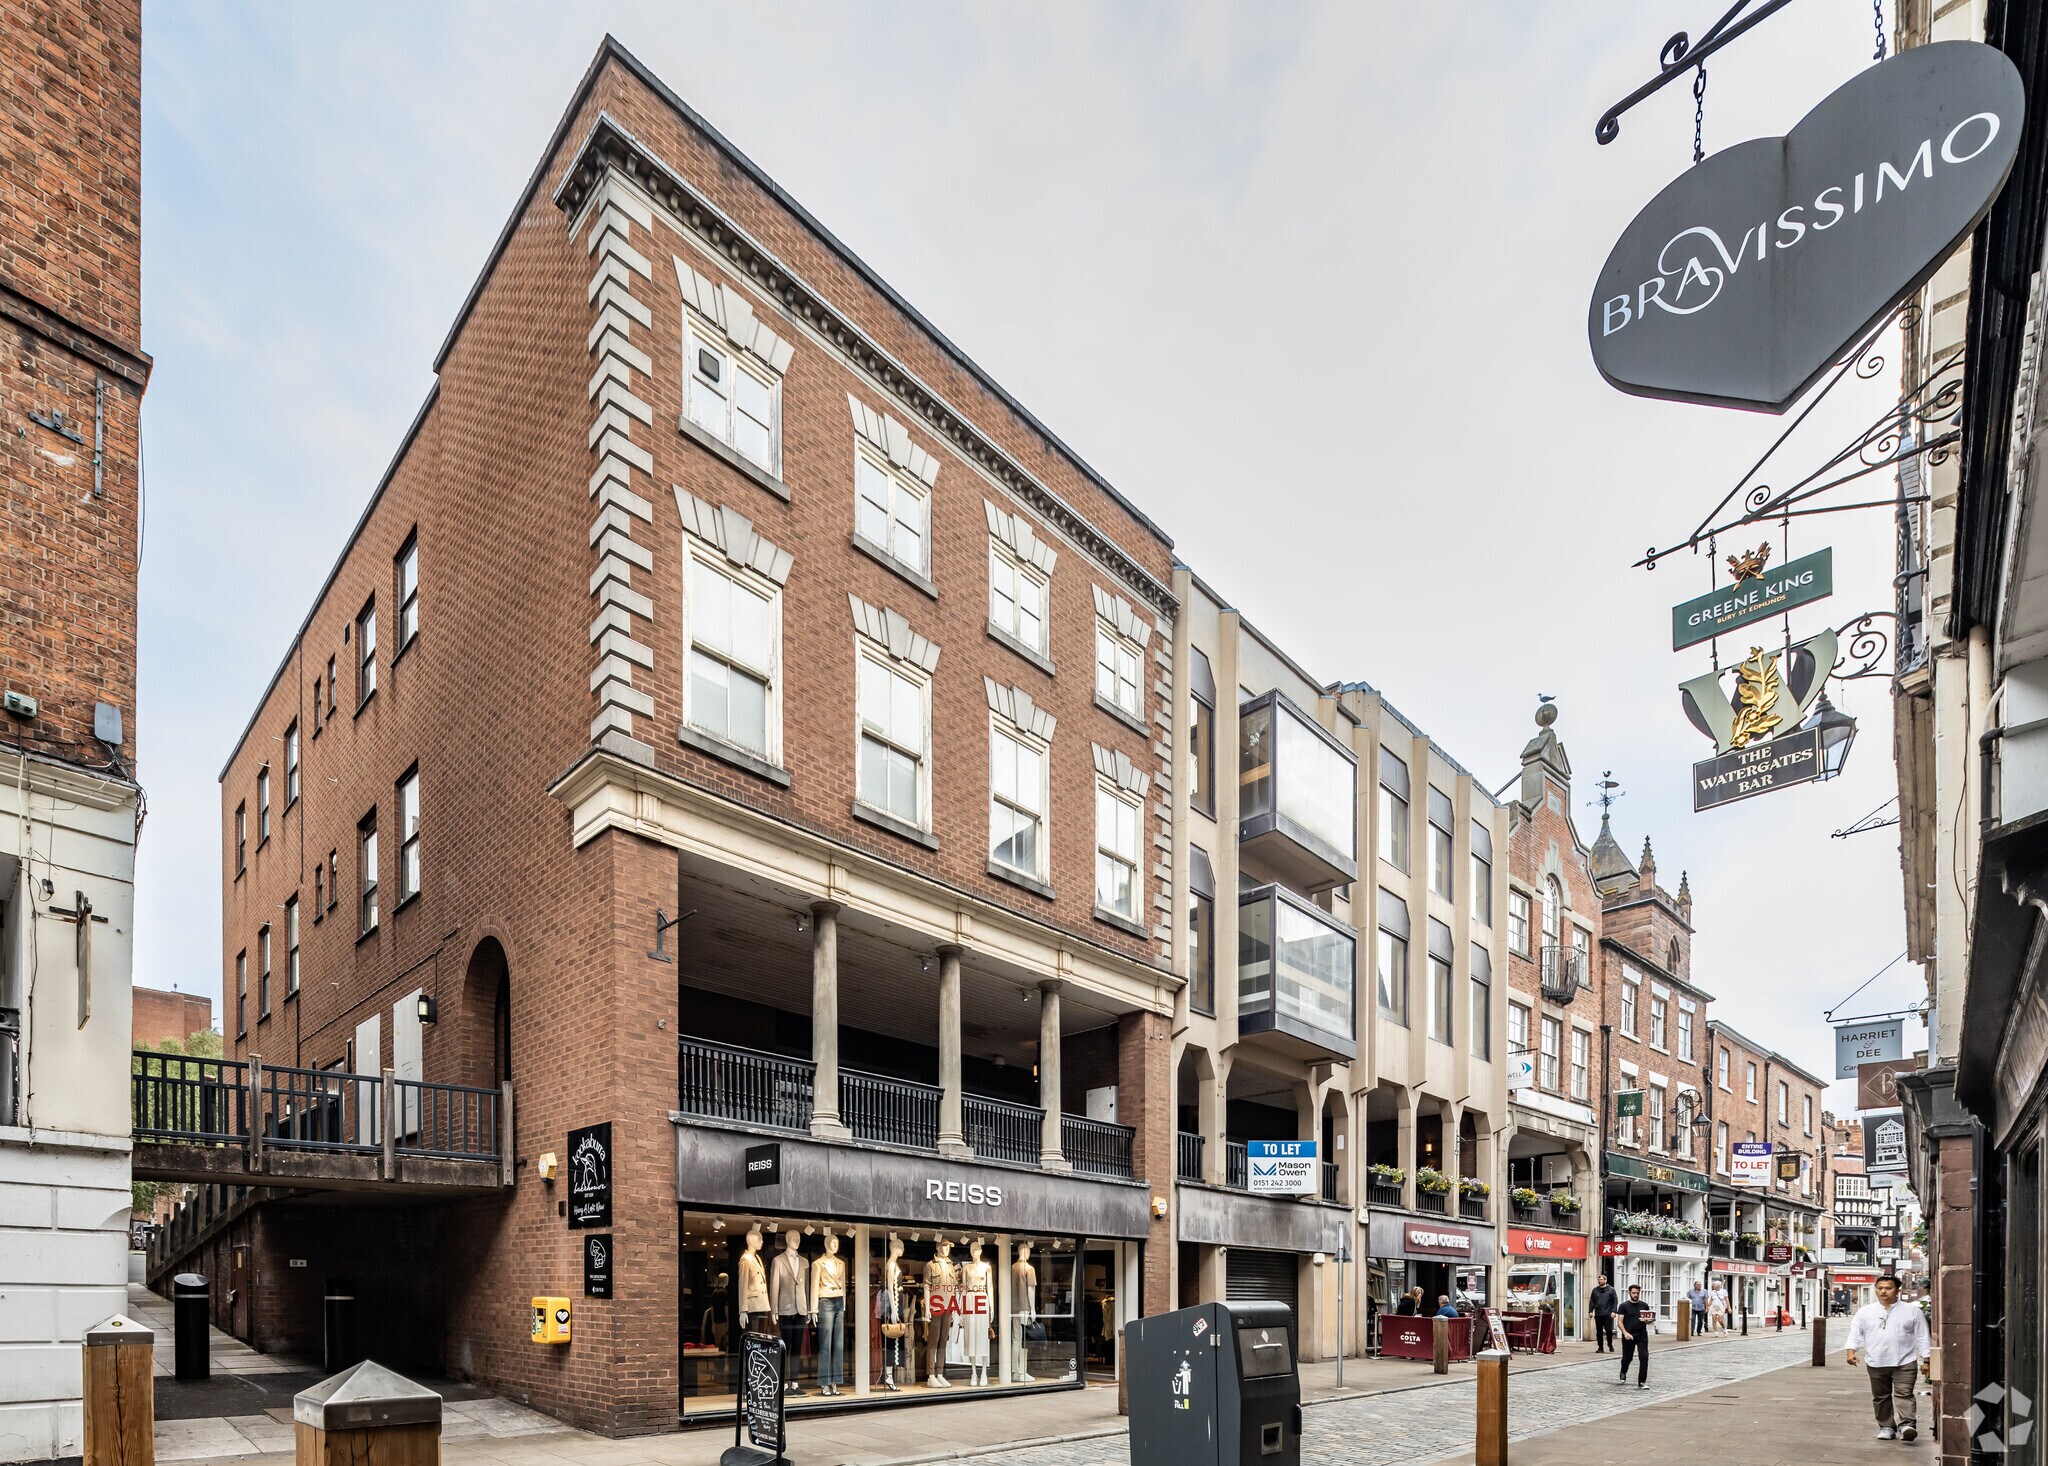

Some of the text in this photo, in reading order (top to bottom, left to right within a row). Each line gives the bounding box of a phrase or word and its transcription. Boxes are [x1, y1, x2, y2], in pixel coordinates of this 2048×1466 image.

[1602, 111, 2001, 337] BRAVISSIMO
[1688, 570, 1814, 627] GREENE KING
[1716, 594, 1787, 625] BURY ST EDMUNDS
[1737, 746, 1772, 765] THE
[1700, 747, 1814, 791] WATERGATES
[1738, 774, 1774, 794] BAR
[1841, 1029, 1897, 1043] HARRIET
[1856, 1048, 1882, 1059] DEE
[1263, 1143, 1301, 1155] TO LET
[748, 1159, 772, 1171] REISS
[1278, 1161, 1311, 1169] Mason
[1734, 1161, 1769, 1170] TO LET
[926, 1179, 1002, 1207] REISS
[1411, 1231, 1470, 1249] COSTA COFFEE
[929, 1284, 940, 1293] UP
[942, 1284, 953, 1293] TO
[929, 1295, 987, 1317] SALE
[1400, 1334, 1421, 1342] COSTA
